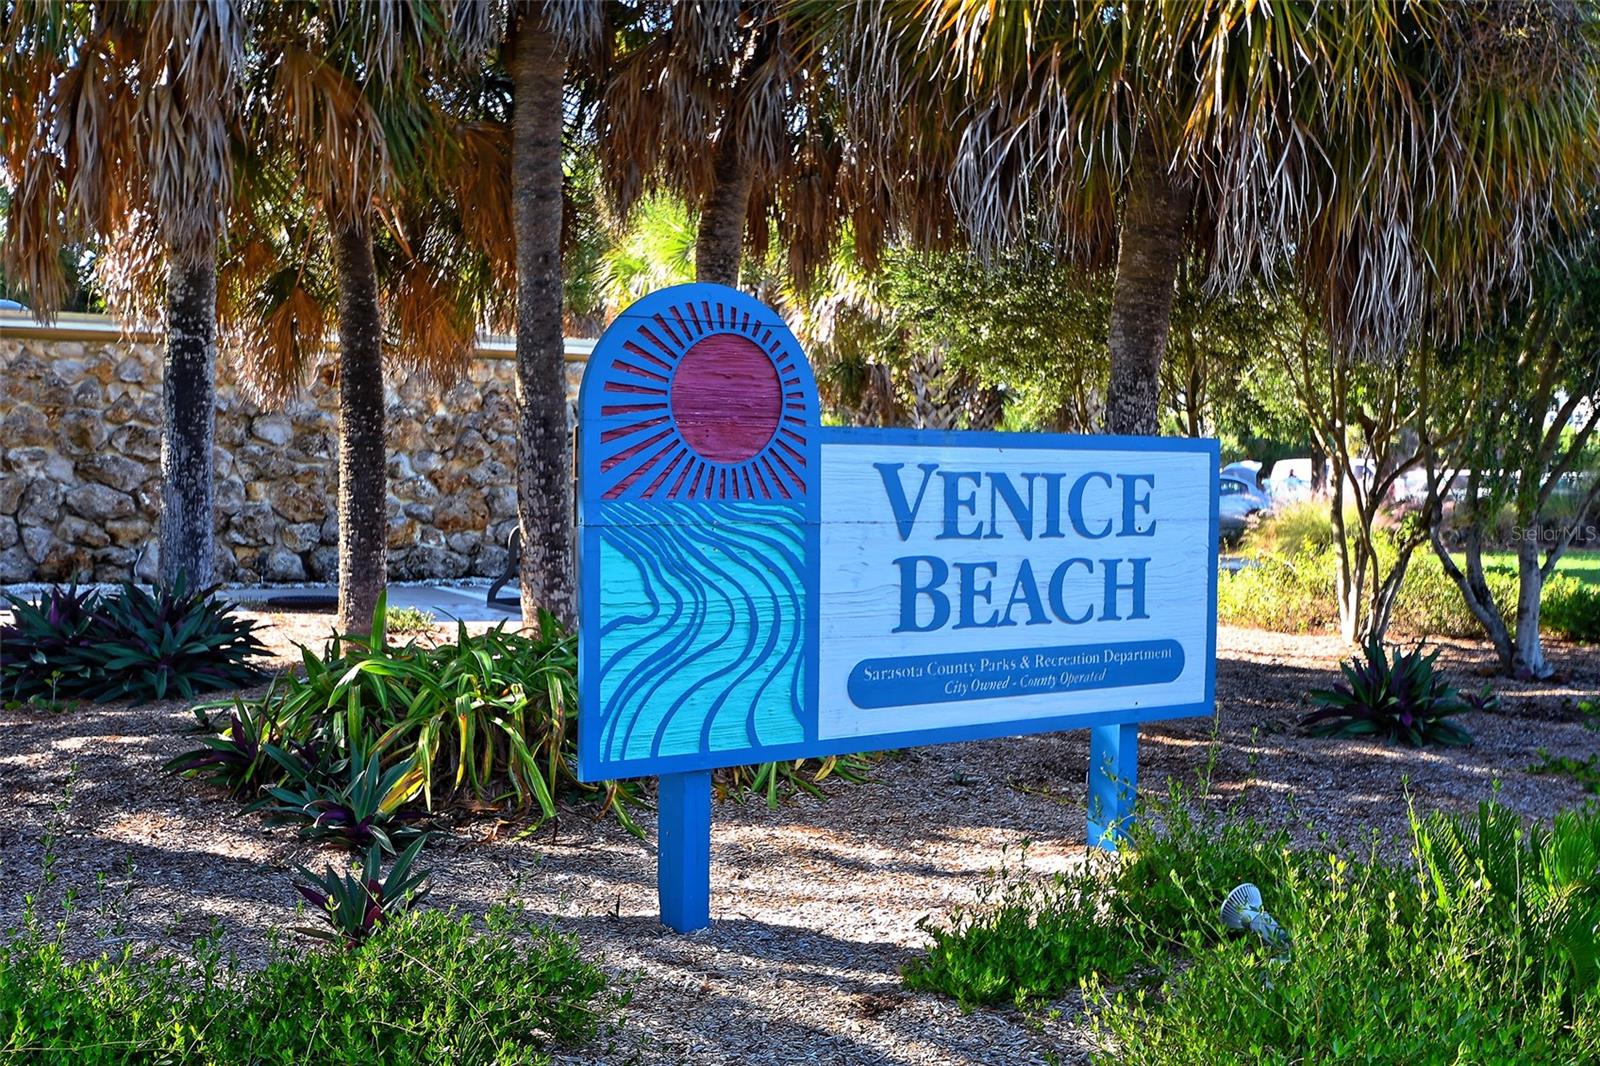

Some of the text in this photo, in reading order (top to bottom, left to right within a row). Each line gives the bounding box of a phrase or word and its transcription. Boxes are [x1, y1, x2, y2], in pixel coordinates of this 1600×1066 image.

[873, 462, 1157, 542] VENICE
[891, 555, 1151, 634] BEACH
[863, 648, 1173, 681] Sarasota County Parks & Recreation Department
[944, 679, 968, 696] City
[971, 675, 1011, 692] Owned
[1020, 673, 1056, 689] County
[1060, 667, 1107, 687] Operated
